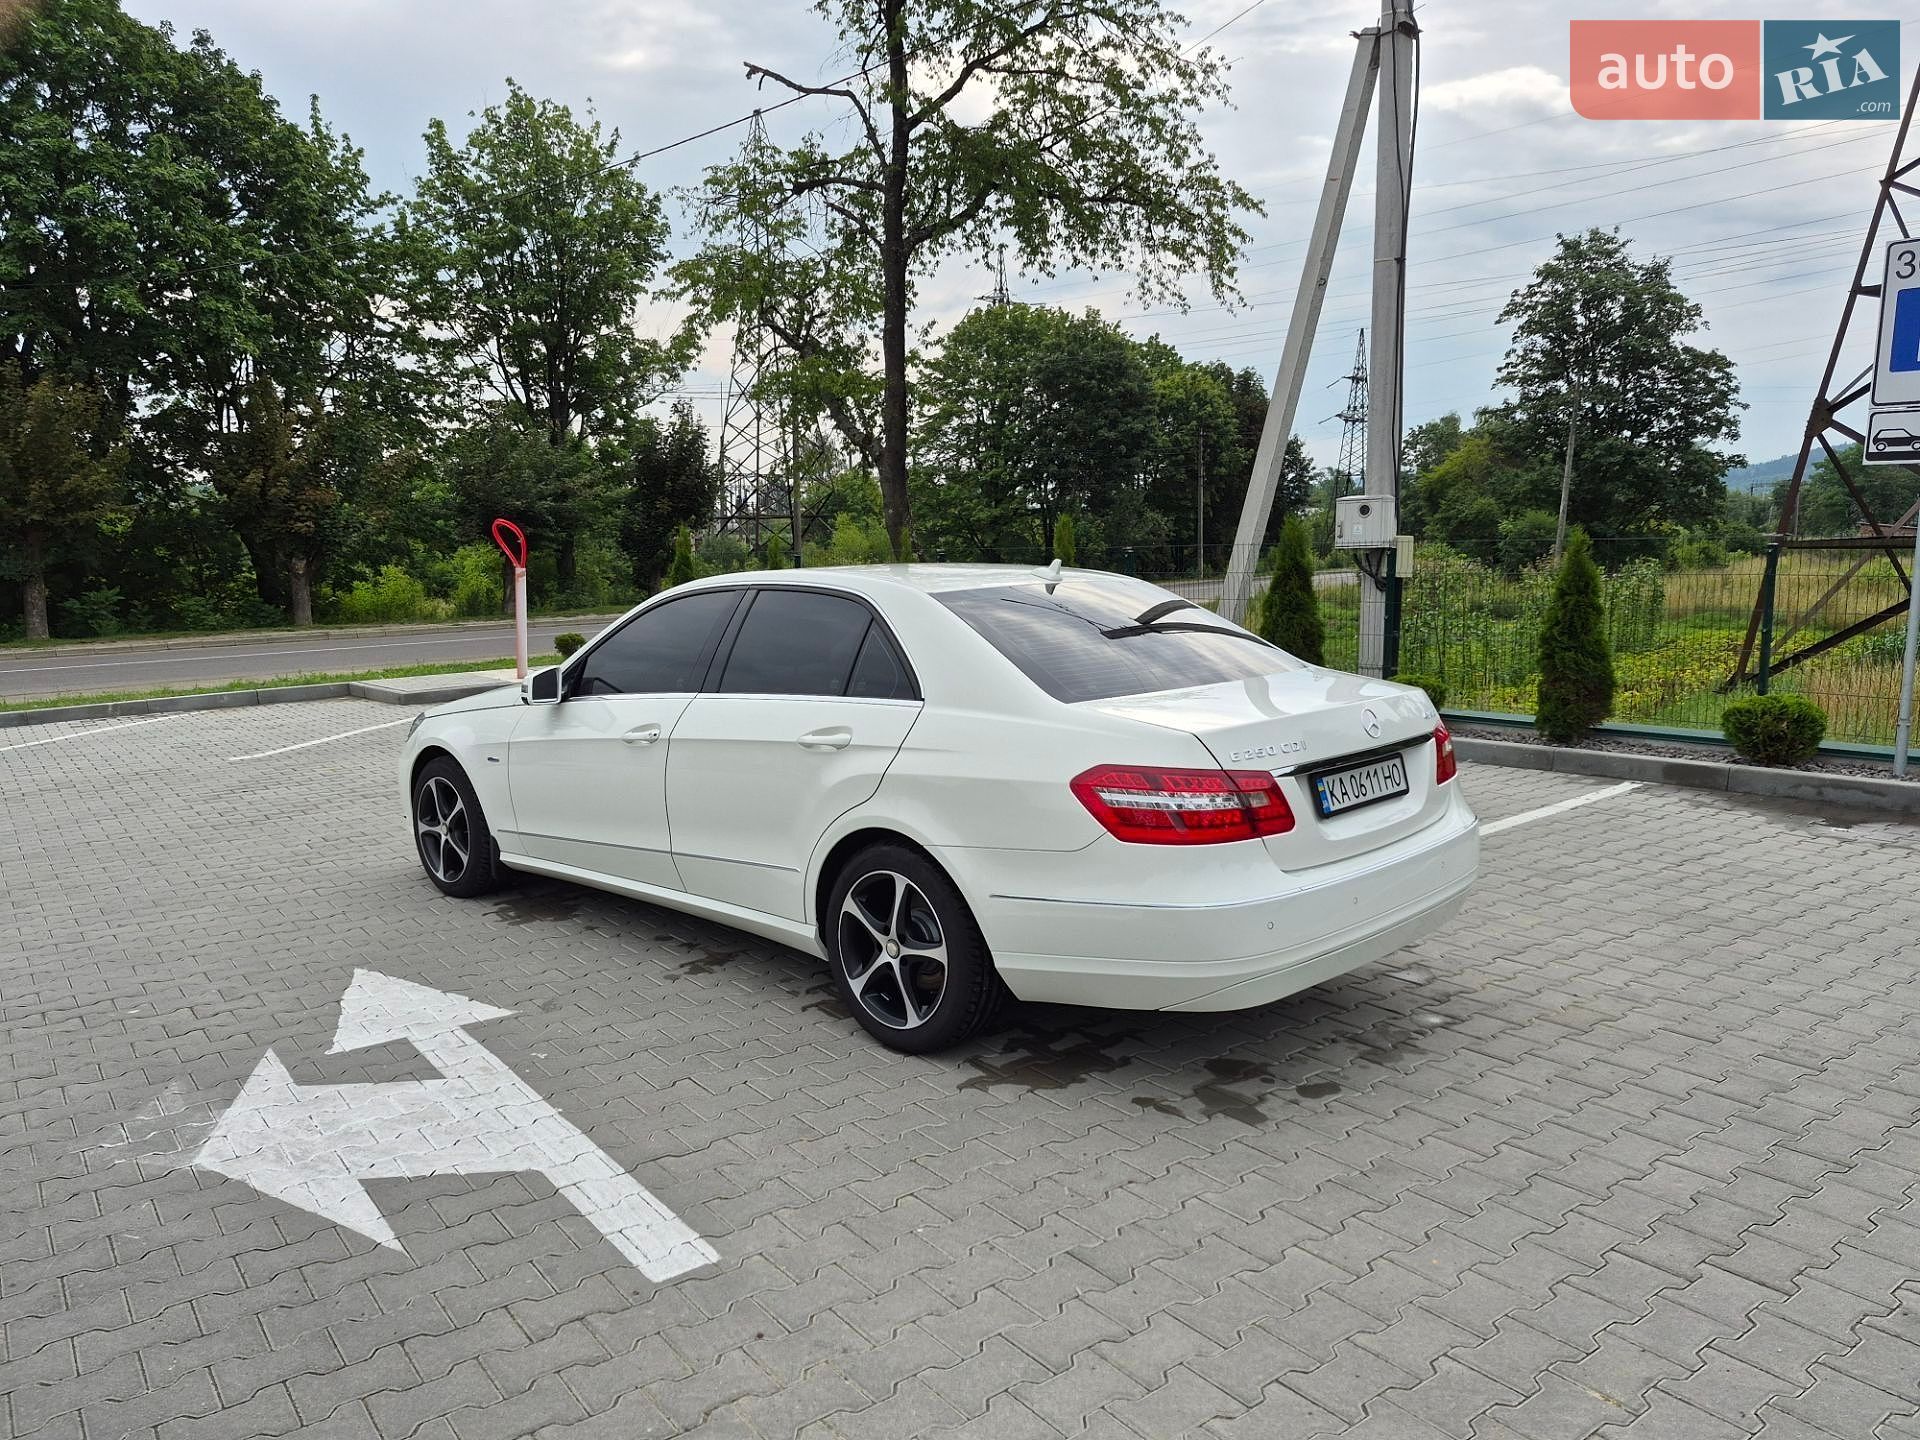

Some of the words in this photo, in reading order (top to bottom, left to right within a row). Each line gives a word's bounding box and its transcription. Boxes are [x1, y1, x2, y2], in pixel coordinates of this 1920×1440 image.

[1230, 752, 1241, 762] E
[1244, 745, 1277, 760] 250
[1280, 739, 1307, 754] CDI
[1326, 777, 1352, 806] KA
[1349, 767, 1383, 799] 0611
[1380, 763, 1402, 791] HO
